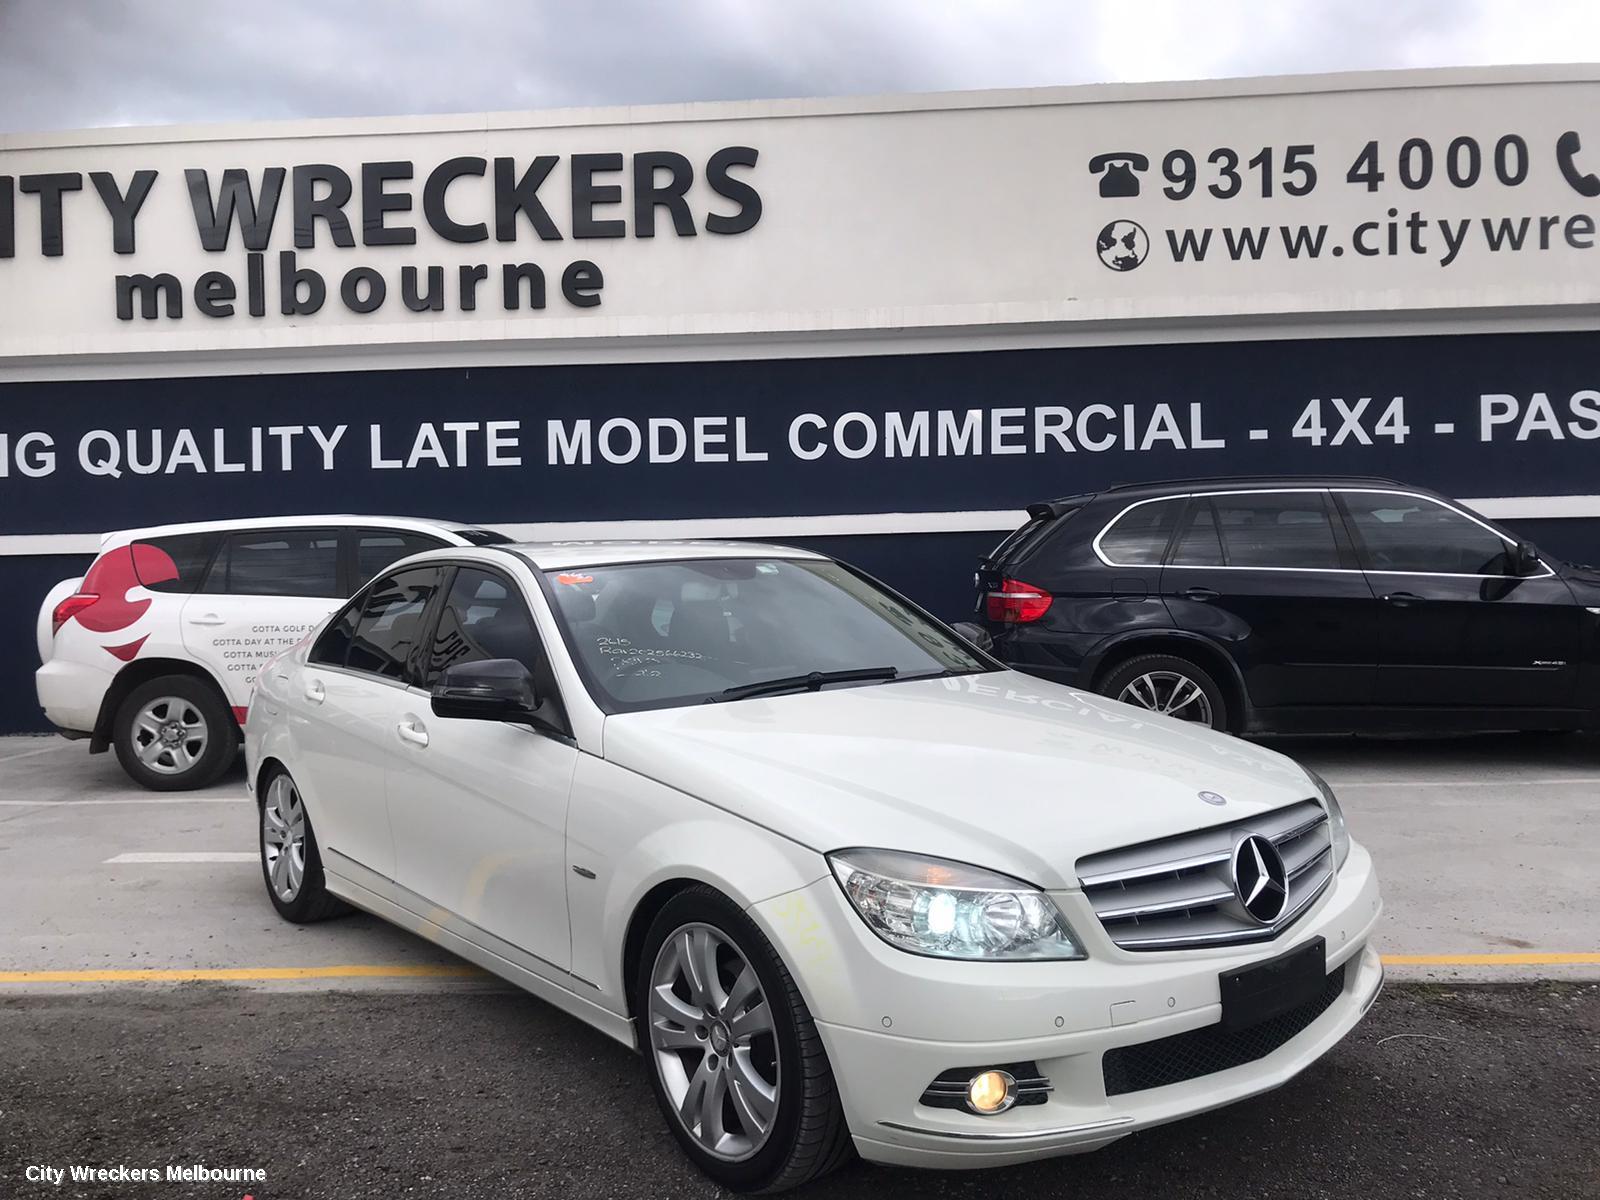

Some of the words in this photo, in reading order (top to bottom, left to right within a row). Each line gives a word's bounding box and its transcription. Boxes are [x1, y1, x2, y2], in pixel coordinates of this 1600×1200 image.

[184, 145, 763, 252] WRECKERS
[1161, 145, 1318, 201] 9315
[1346, 134, 1529, 193] 4000
[1165, 208, 1596, 268] www.citywre
[114, 250, 604, 321] melbourne
[78, 424, 348, 479] QUALITY
[370, 420, 522, 469] LATE
[547, 416, 769, 465] MODEL
[788, 402, 1226, 460] COMMERCIAL
[1292, 396, 1410, 446] 4X4
[1480, 390, 1600, 442] PAS
[252, 625, 280, 633] GOTTA
[283, 625, 305, 633] GOLF
[255, 650, 278, 658] MUS
